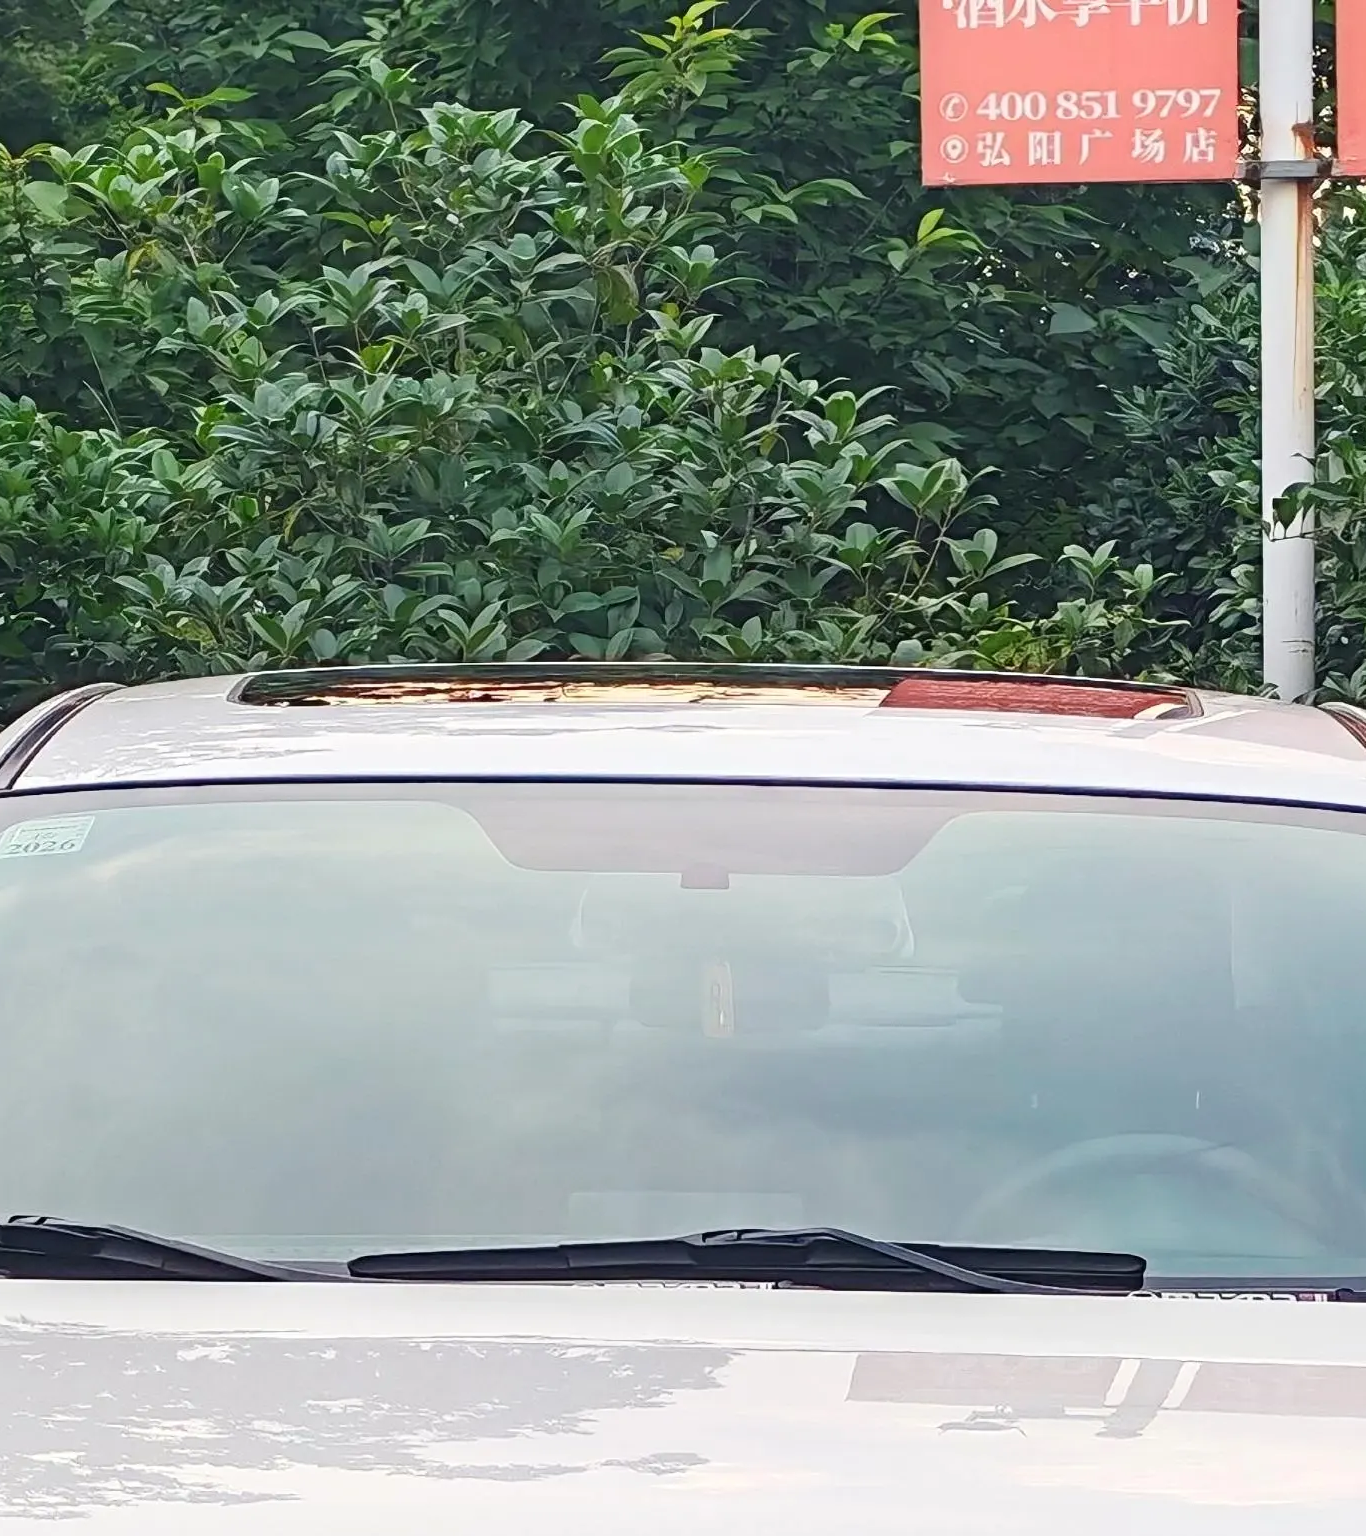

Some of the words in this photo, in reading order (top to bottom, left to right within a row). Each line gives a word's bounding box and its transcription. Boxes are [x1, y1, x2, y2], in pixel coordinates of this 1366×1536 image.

[976, 91, 1047, 121] 400
[1055, 90, 1122, 120] 851
[1131, 88, 1221, 119] 9797
[976, 127, 1218, 167] 弘阳广场店
